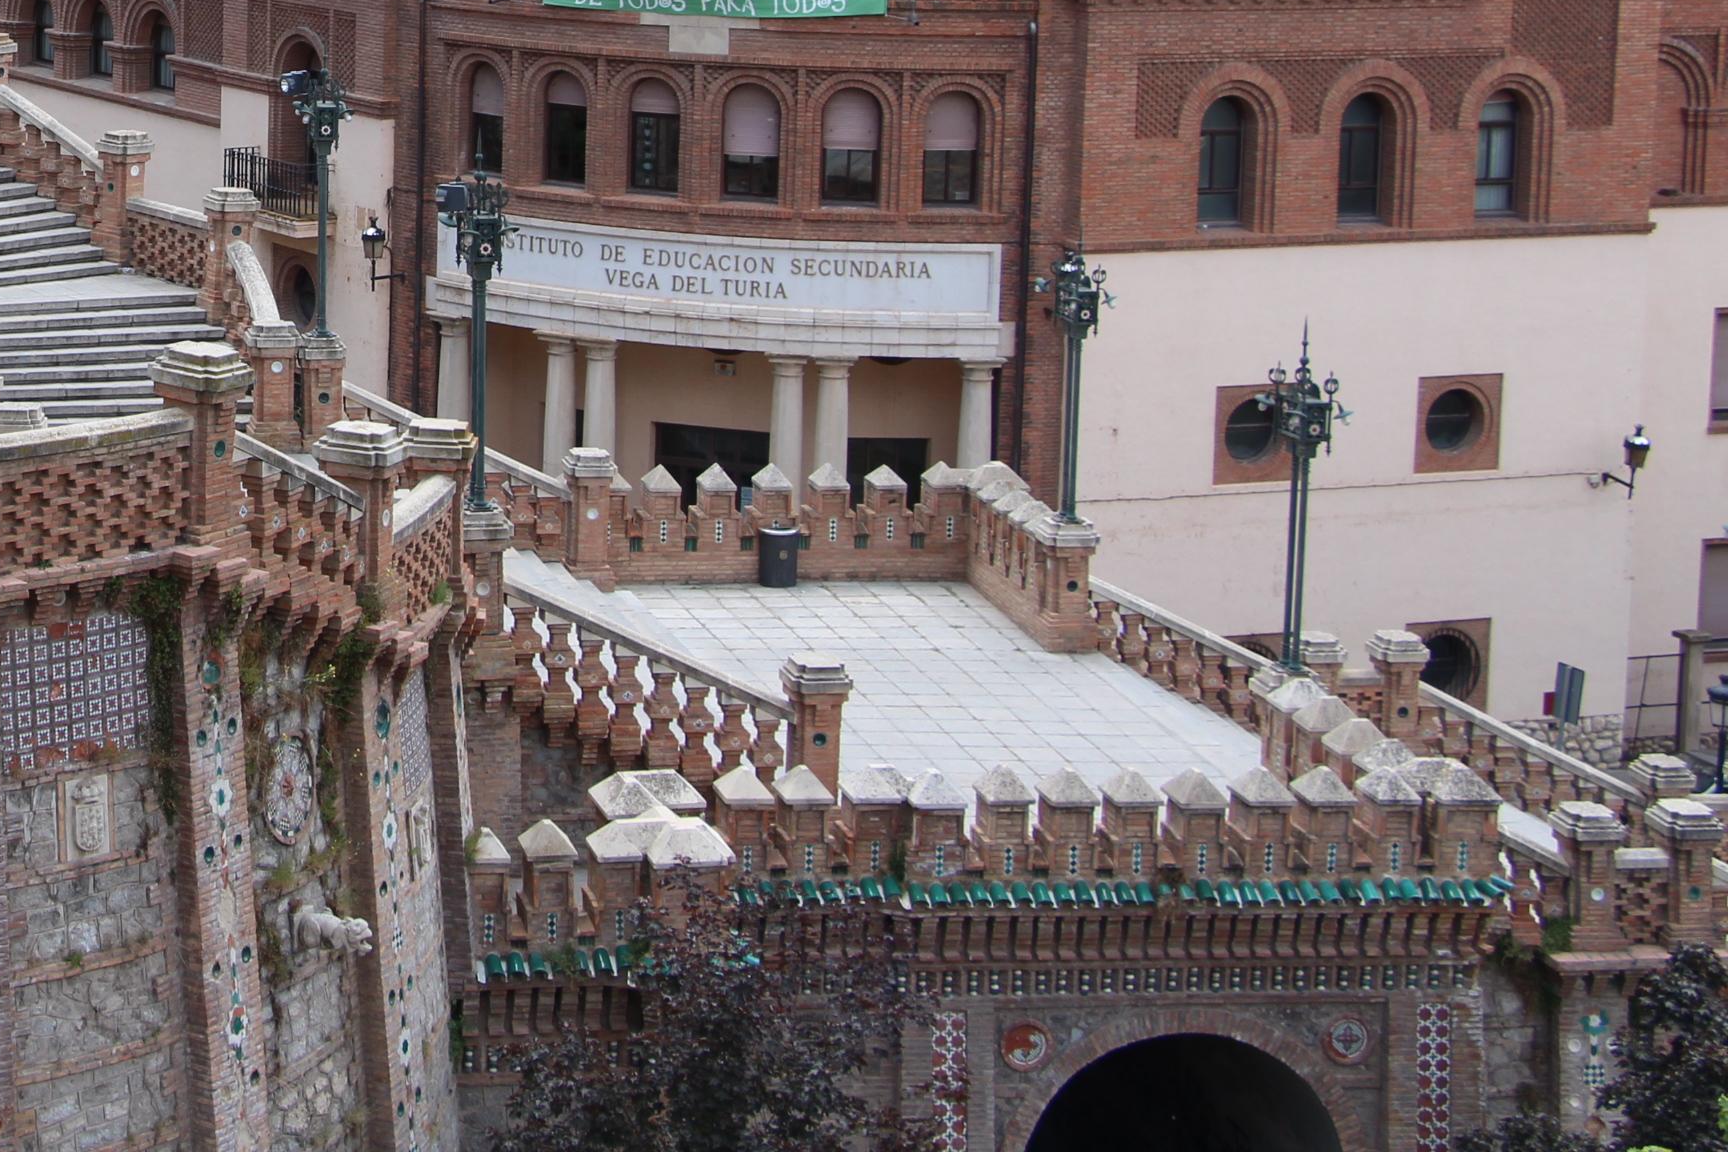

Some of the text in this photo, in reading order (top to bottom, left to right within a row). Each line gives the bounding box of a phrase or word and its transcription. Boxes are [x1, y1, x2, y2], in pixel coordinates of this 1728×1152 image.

[600, 243, 626, 263] DE
[642, 247, 775, 275] EDUCACION
[789, 258, 932, 279] SECUNDARIA
[604, 267, 788, 299] VEGA DEL TURIA
